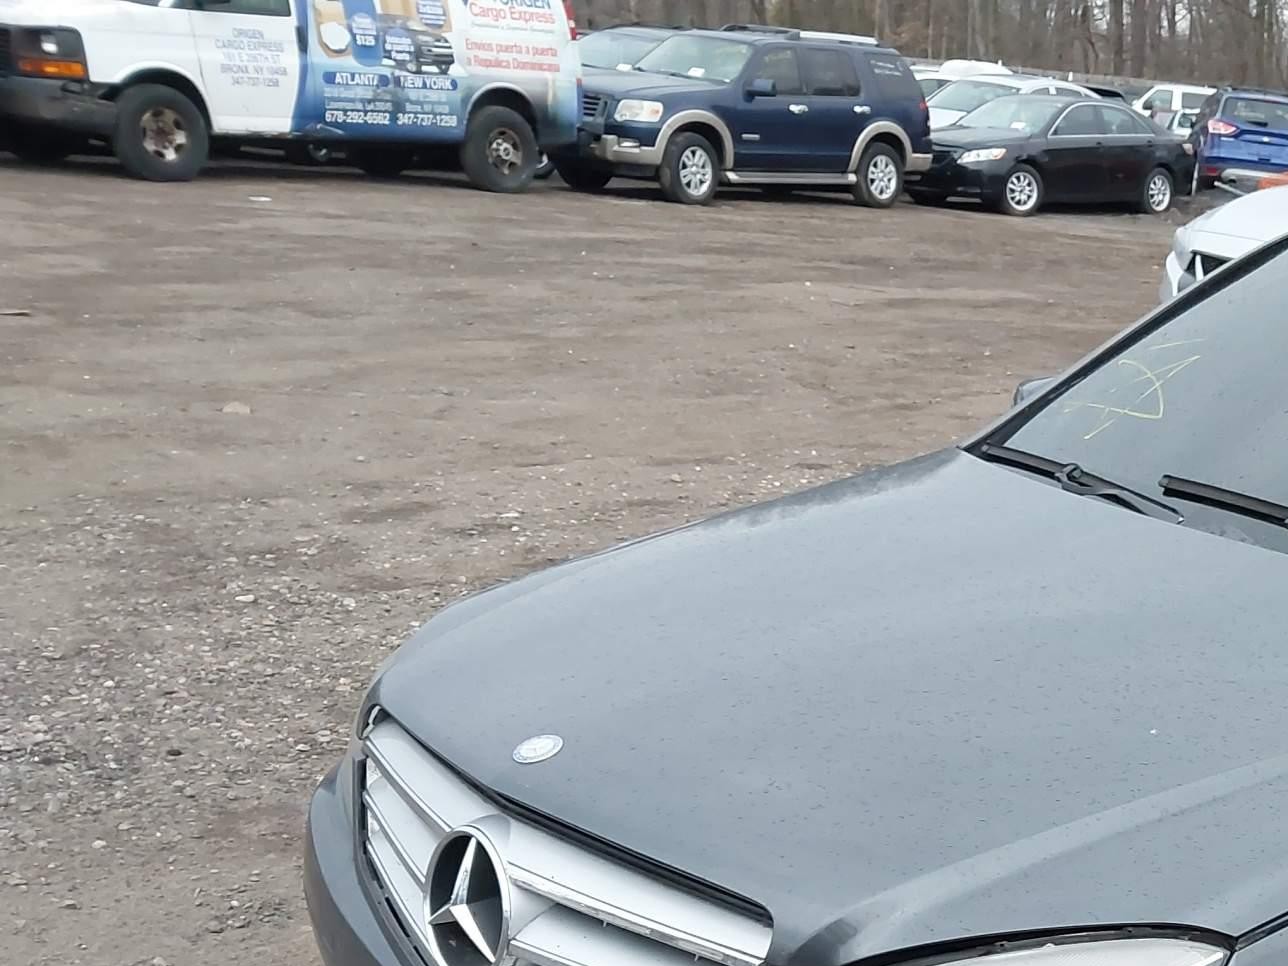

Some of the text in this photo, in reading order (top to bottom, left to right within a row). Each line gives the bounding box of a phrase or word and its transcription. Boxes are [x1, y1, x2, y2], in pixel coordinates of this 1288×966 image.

[469, 2, 556, 24] Cargo Express
[400, 75, 453, 91] NEW YORK
